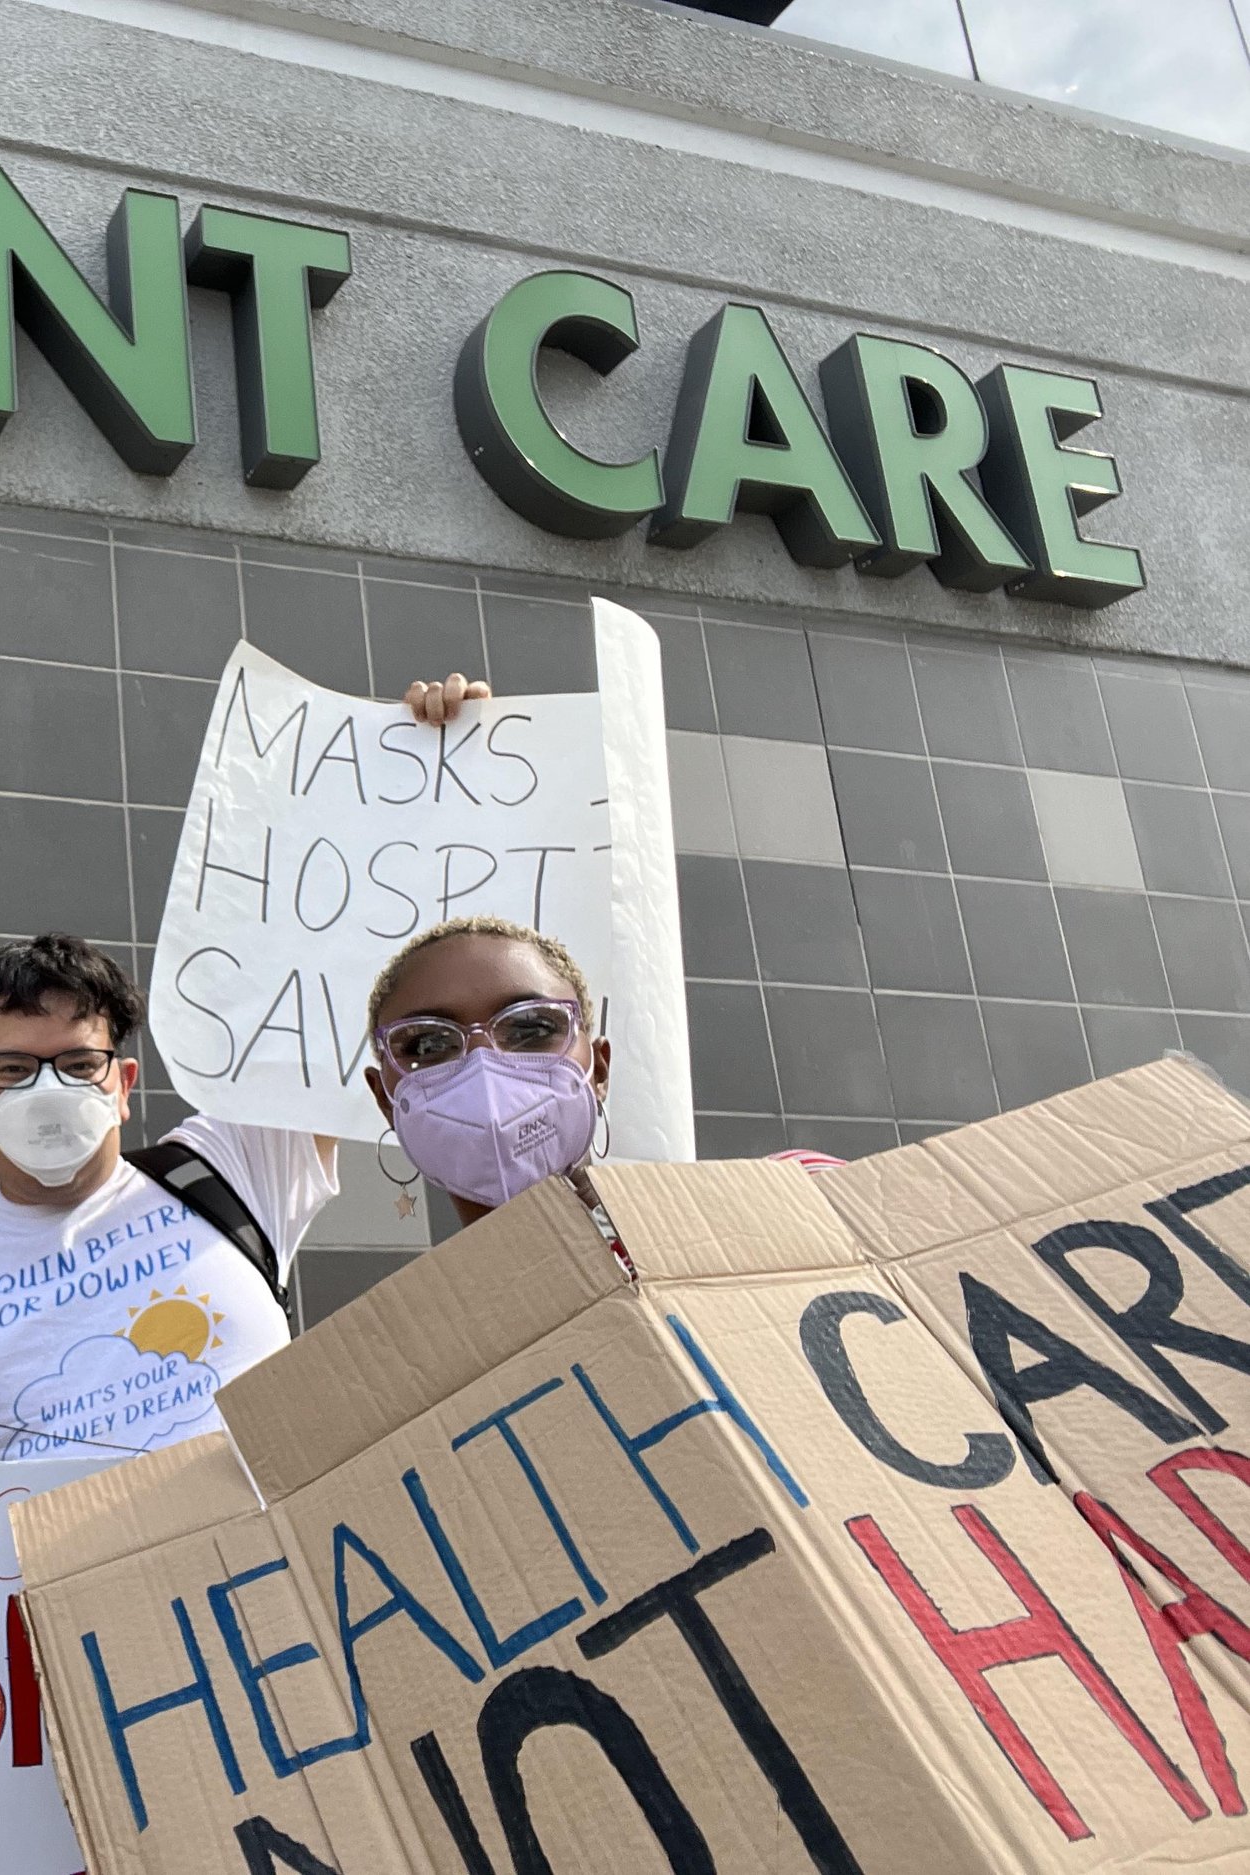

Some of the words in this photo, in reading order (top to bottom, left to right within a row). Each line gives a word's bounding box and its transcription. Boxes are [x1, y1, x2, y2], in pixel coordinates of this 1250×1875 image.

[456, 270, 1146, 604] CARE
[214, 666, 538, 807] MASKS
[54, 1239, 192, 1308] DOWNEY
[18, 1412, 117, 1459] DOWNEY
[125, 1375, 213, 1426] DREAM?
[40, 1382, 117, 1424] WHAT'S
[122, 1359, 179, 1397] YOUR
[81, 1314, 809, 1835] HEALTH
